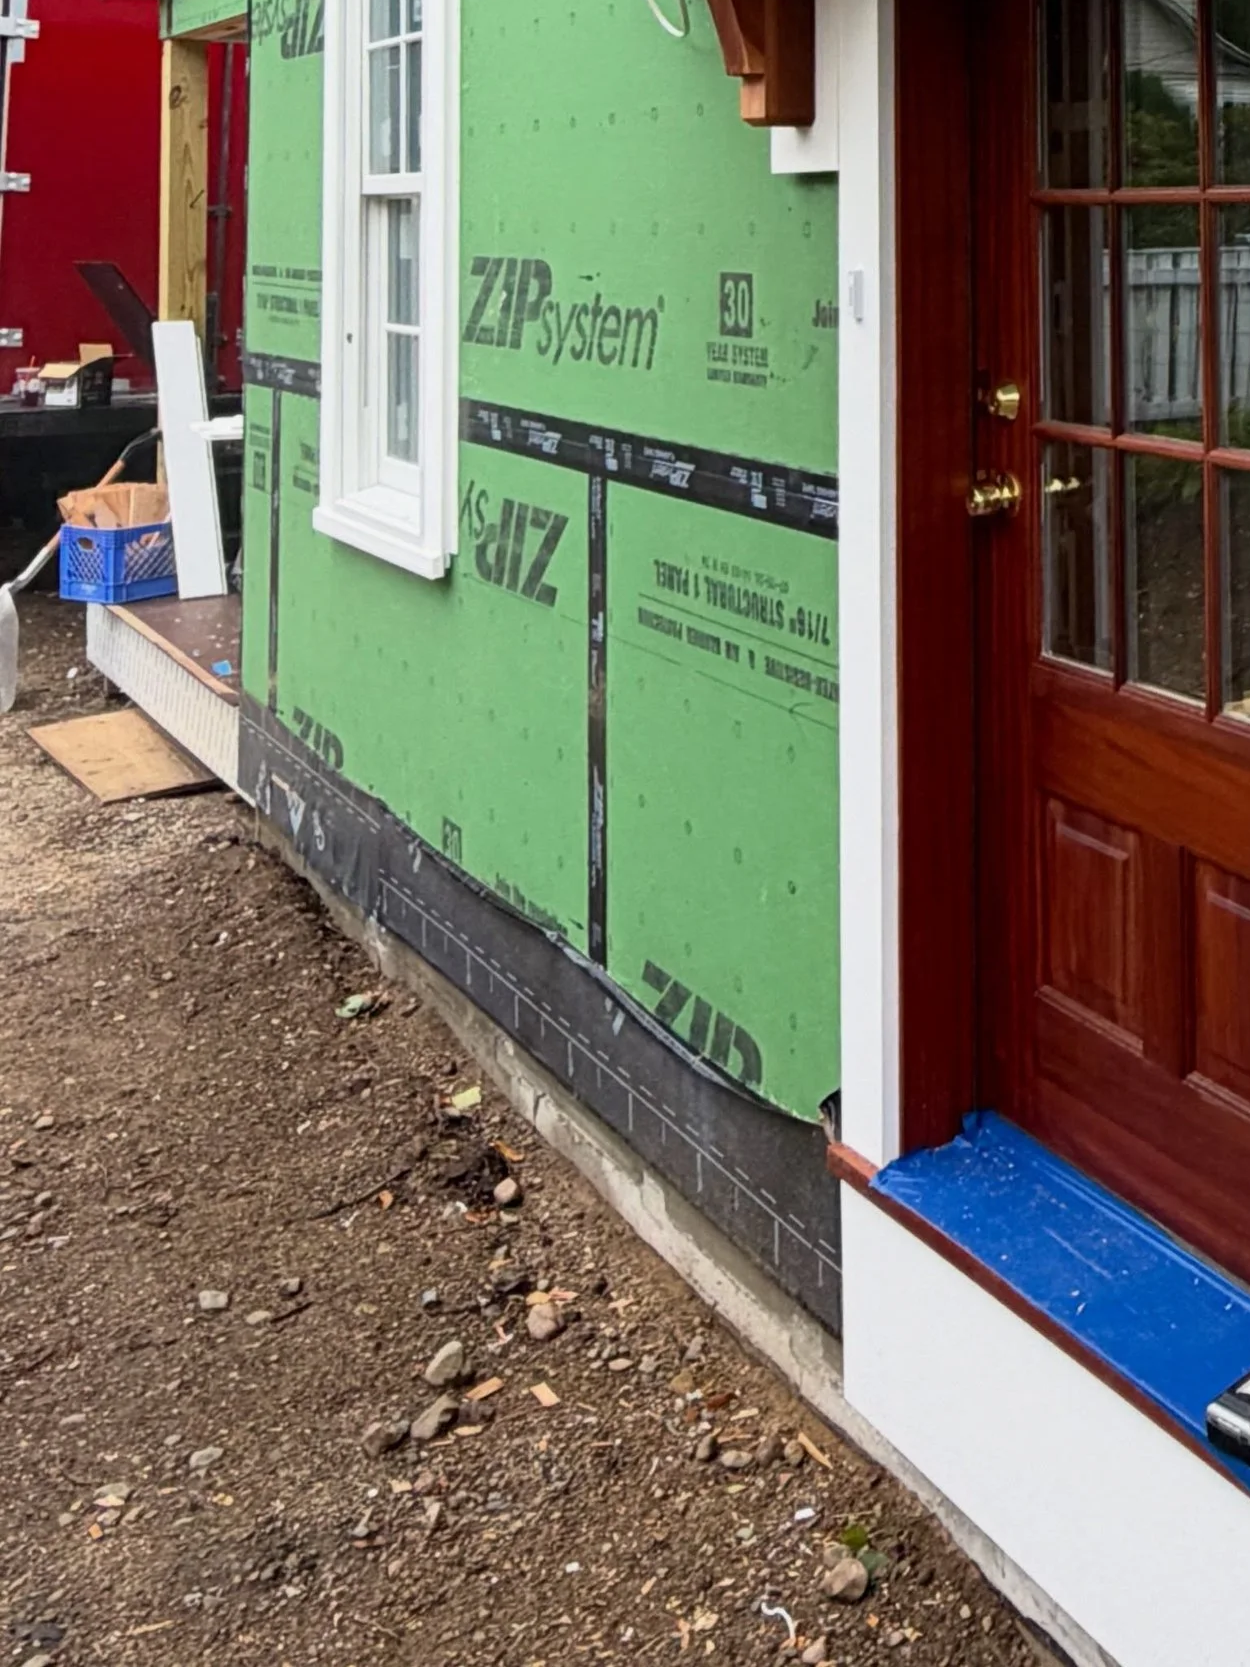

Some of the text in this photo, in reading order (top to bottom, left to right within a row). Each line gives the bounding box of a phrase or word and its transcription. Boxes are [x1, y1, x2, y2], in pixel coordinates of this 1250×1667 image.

[723, 279, 750, 329] 30
[653, 559, 690, 597] PANEL
[703, 575, 785, 630] STRUCTURAL
